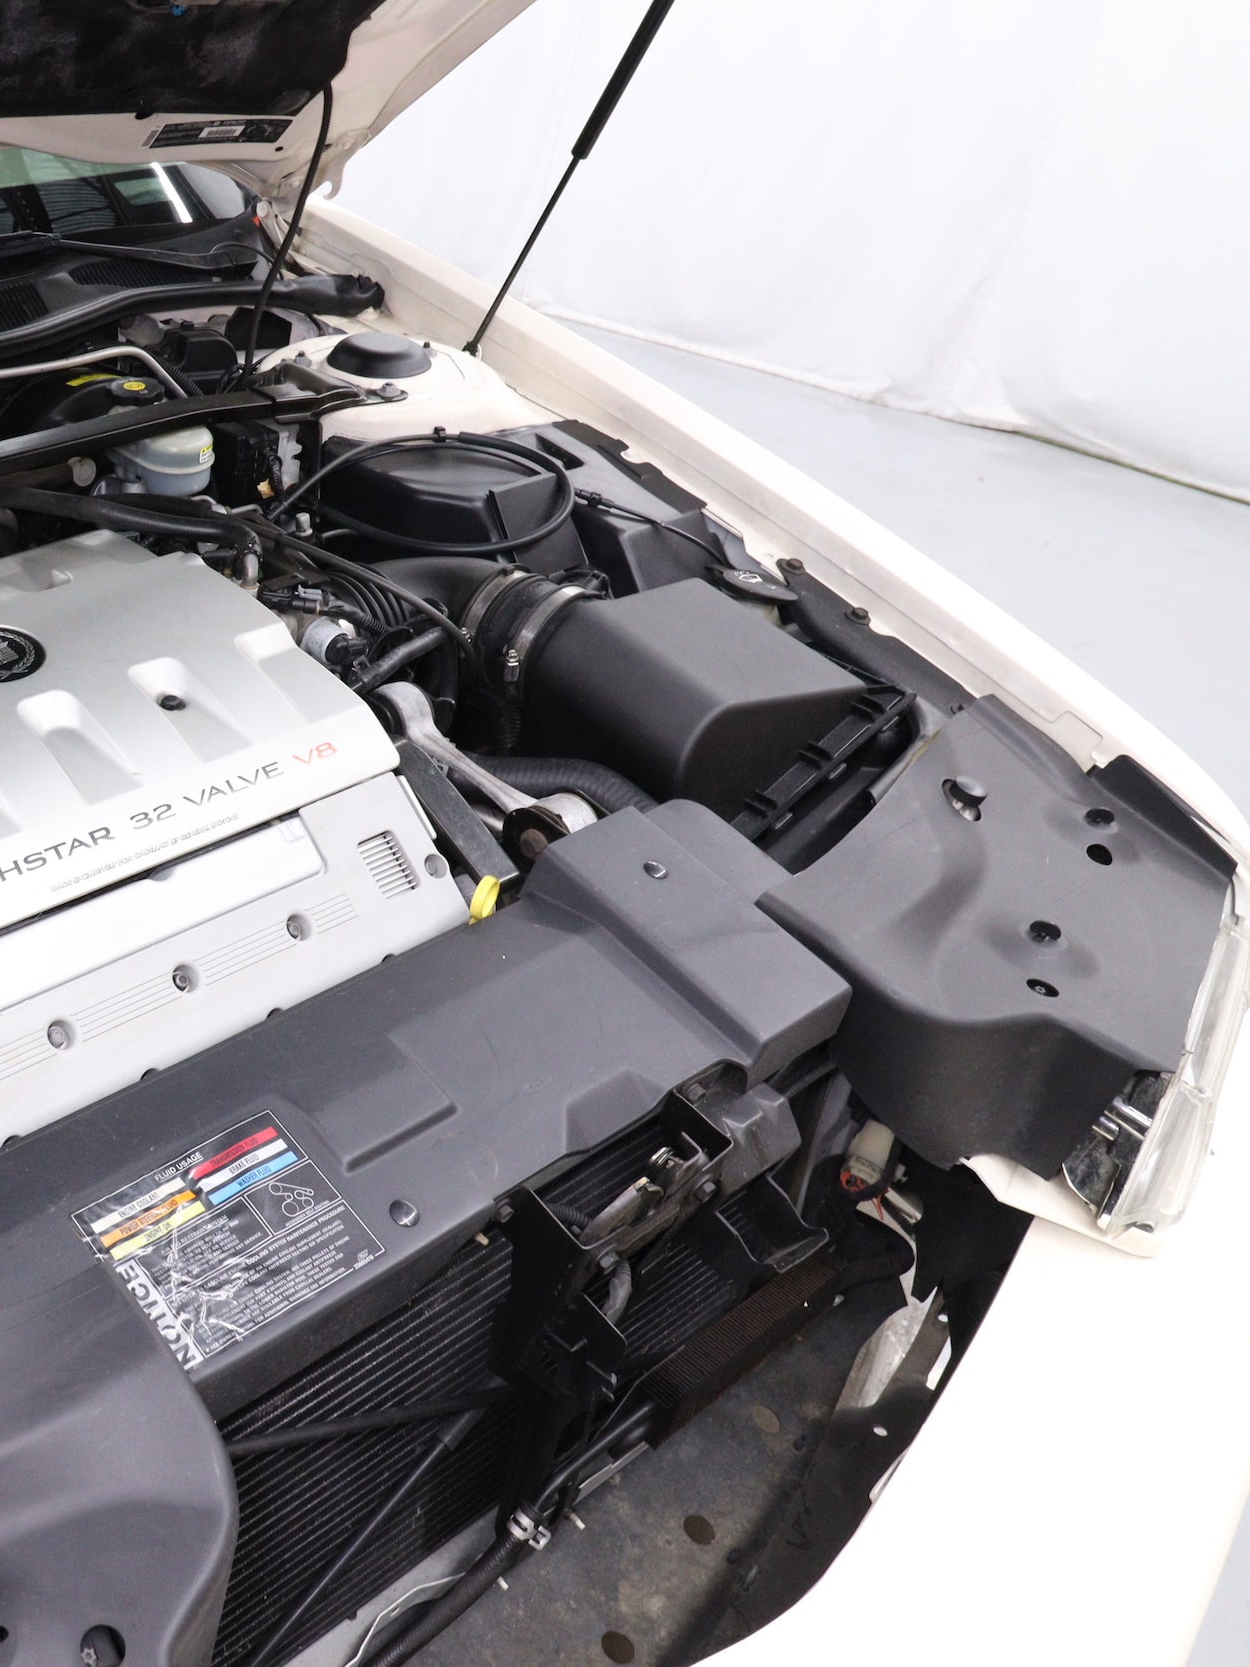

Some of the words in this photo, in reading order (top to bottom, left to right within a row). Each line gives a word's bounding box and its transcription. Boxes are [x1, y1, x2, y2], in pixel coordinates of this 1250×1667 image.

[130, 803, 176, 830] 32
[184, 761, 284, 806] VALVE
[292, 741, 336, 765] V8
[154, 1165, 176, 1181] FLUID
[175, 1151, 202, 1170] USAGE
[228, 1160, 246, 1174] BRAKE
[243, 1152, 259, 1165] FLUID
[237, 1171, 258, 1188] WASHER
[256, 1164, 272, 1177] FLUID
[118, 1203, 137, 1218] ENGINE
[135, 1191, 159, 1208] COOLANT
[119, 1220, 140, 1236] POWER
[246, 1249, 269, 1264] COOLING
[117, 1264, 202, 1368] NOTICE
